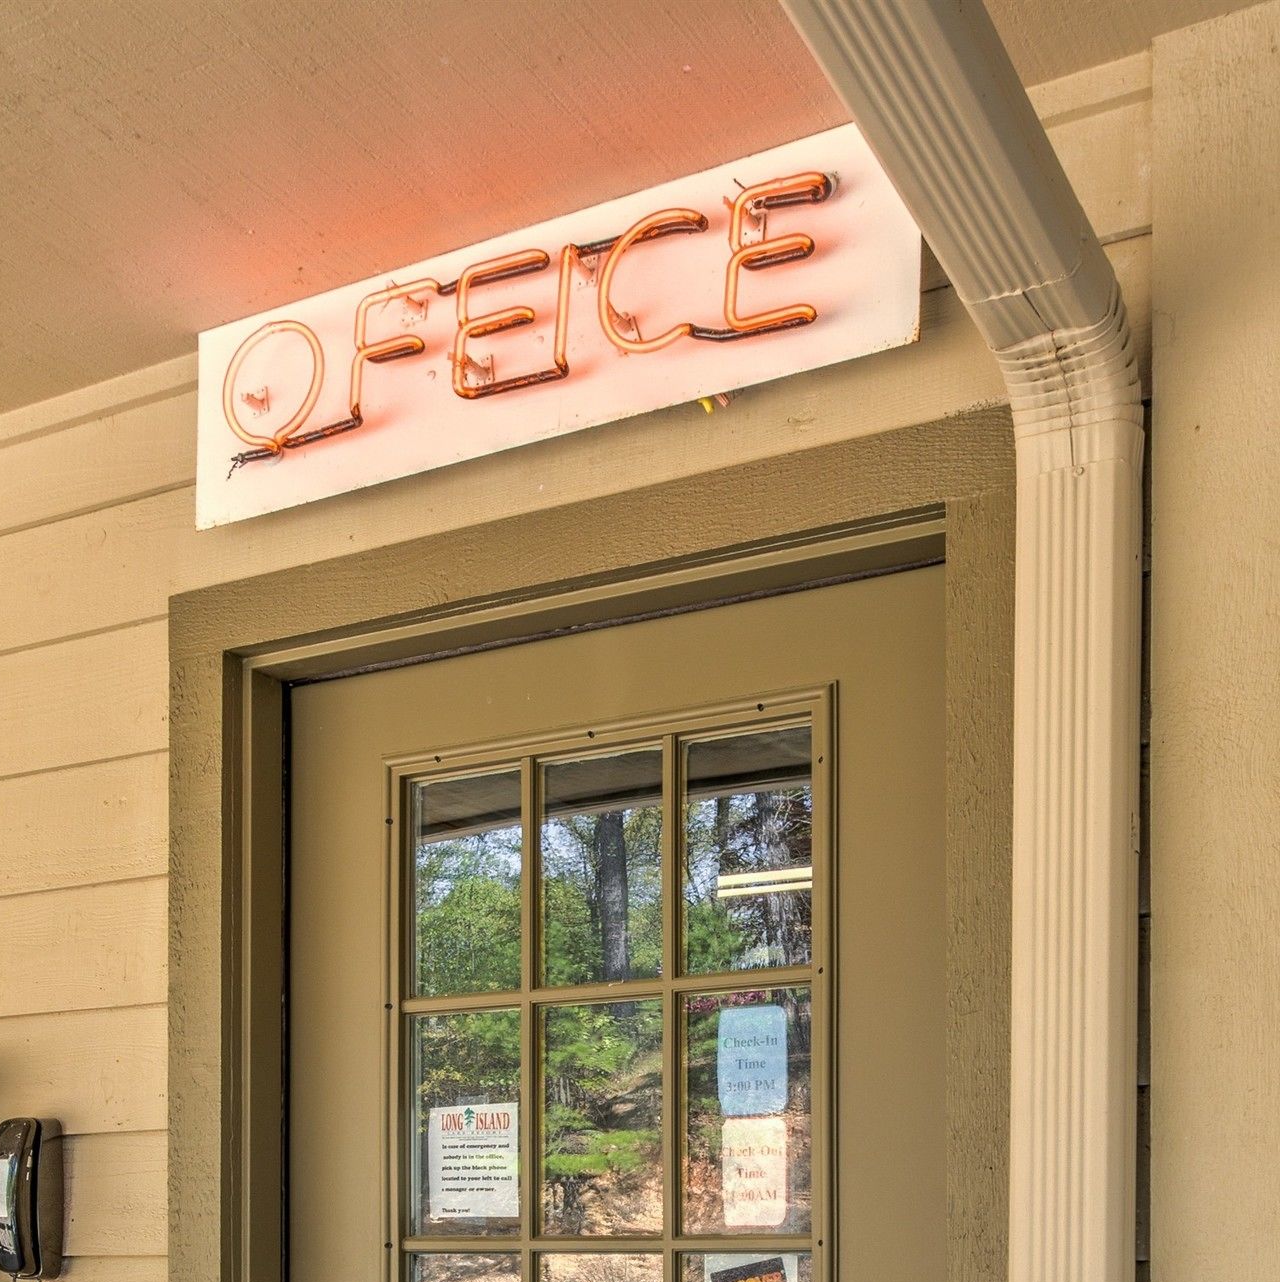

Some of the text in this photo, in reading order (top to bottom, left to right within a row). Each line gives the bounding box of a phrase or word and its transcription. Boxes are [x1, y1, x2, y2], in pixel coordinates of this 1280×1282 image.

[723, 1035, 778, 1049] Check-In
[735, 1058, 767, 1070] Time
[726, 1079, 775, 1093] 3:00 PM
[441, 1112, 510, 1131] LONG ISLAND
[736, 1167, 766, 1179] Time
